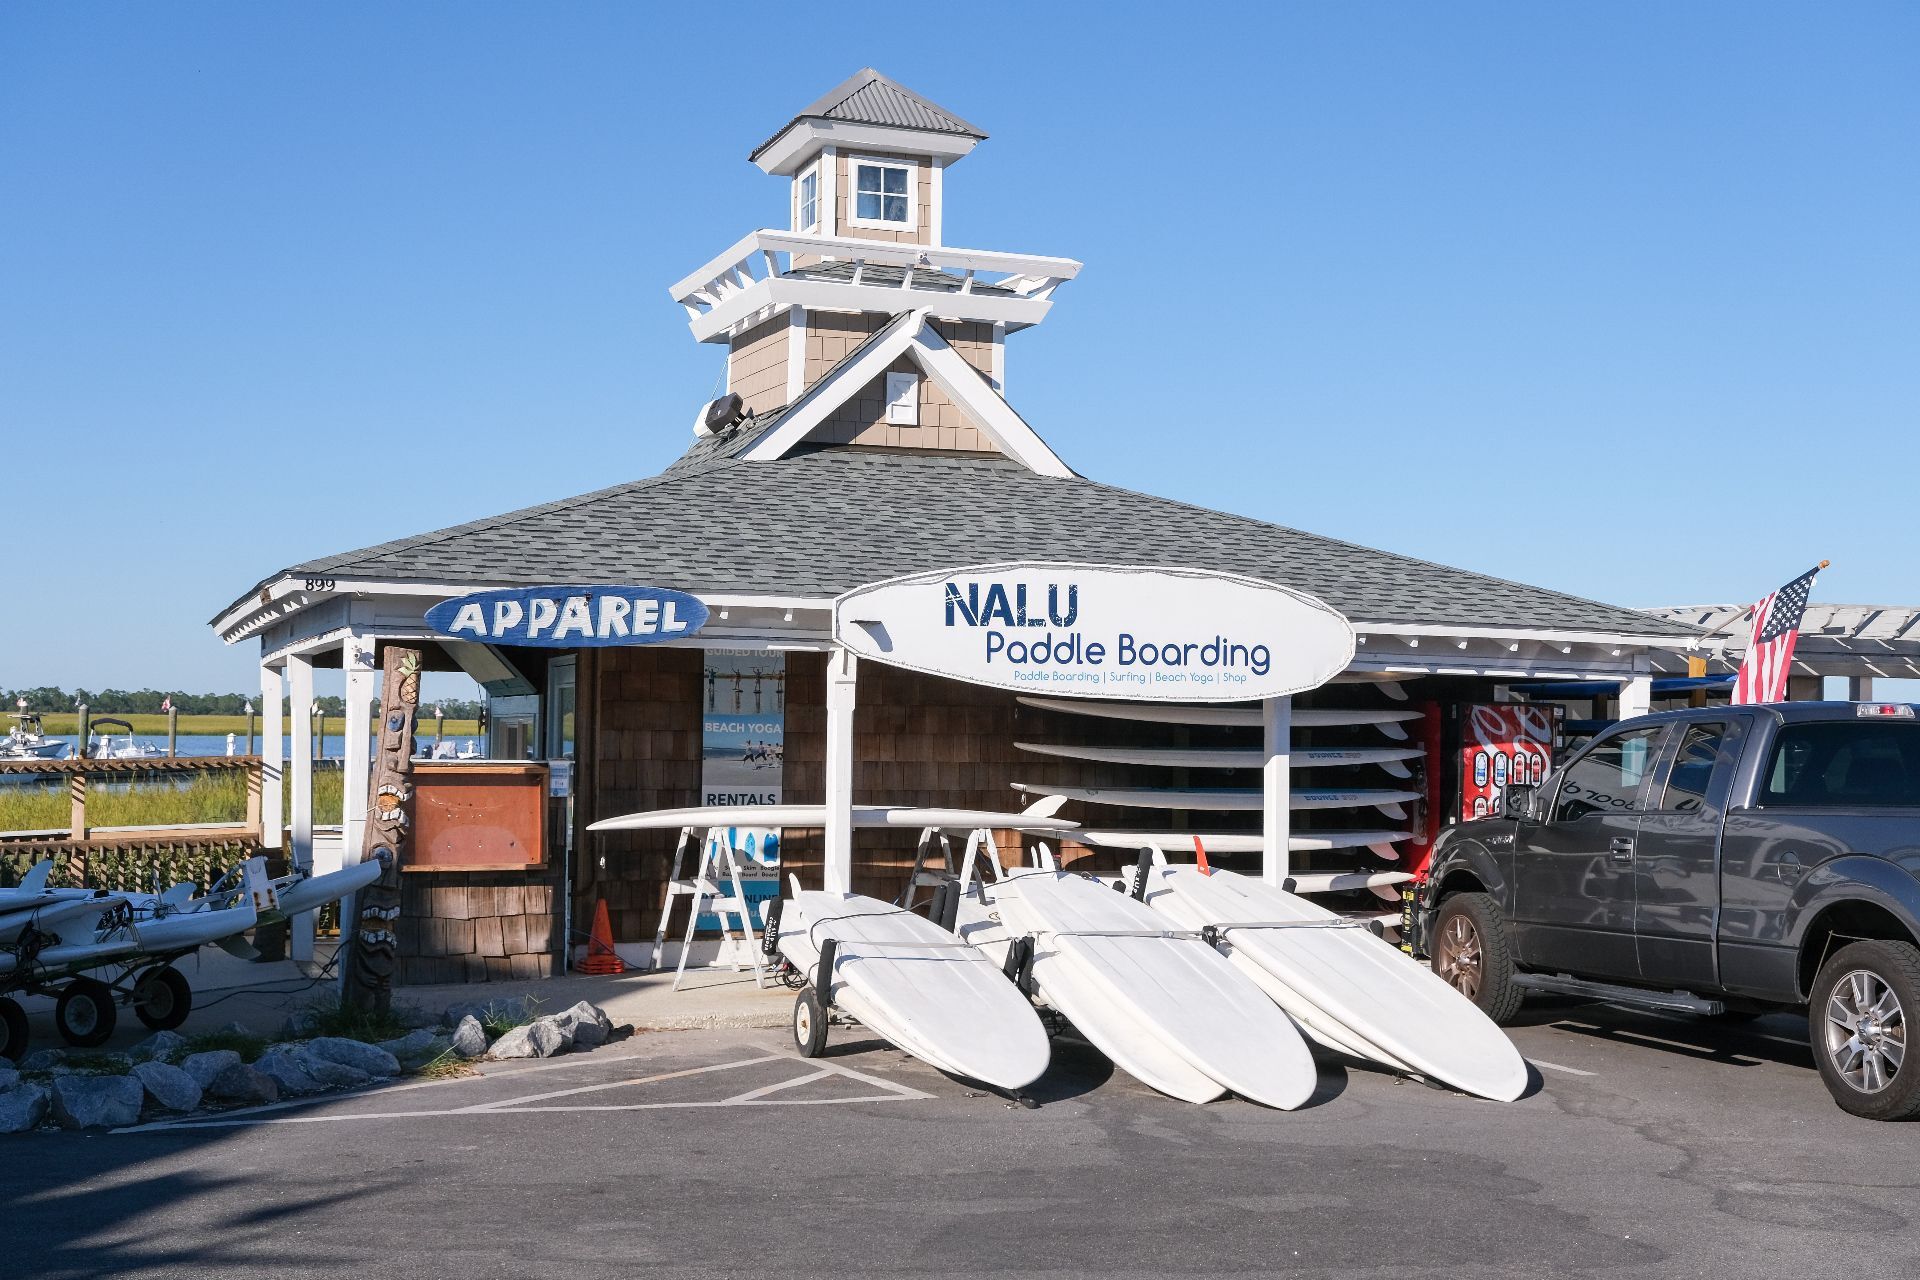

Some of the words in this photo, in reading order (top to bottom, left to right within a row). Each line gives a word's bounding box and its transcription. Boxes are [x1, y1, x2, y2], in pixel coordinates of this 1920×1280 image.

[305, 578, 335, 591] 899
[944, 582, 1078, 628] NALU
[447, 595, 688, 640] APPAREL
[986, 631, 1106, 665] Paddle
[1118, 633, 1271, 676] Boarding
[1014, 670, 1050, 681] Paddle
[1052, 671, 1100, 684] Boarding
[1109, 671, 1146, 685] Surfing
[1155, 672, 1187, 682] Beach
[1189, 672, 1214, 685] Yoga
[1223, 672, 1247, 684] Shop
[704, 722, 745, 733] BEACH
[748, 723, 782, 734] YOGA
[706, 793, 776, 806] RENTALS
